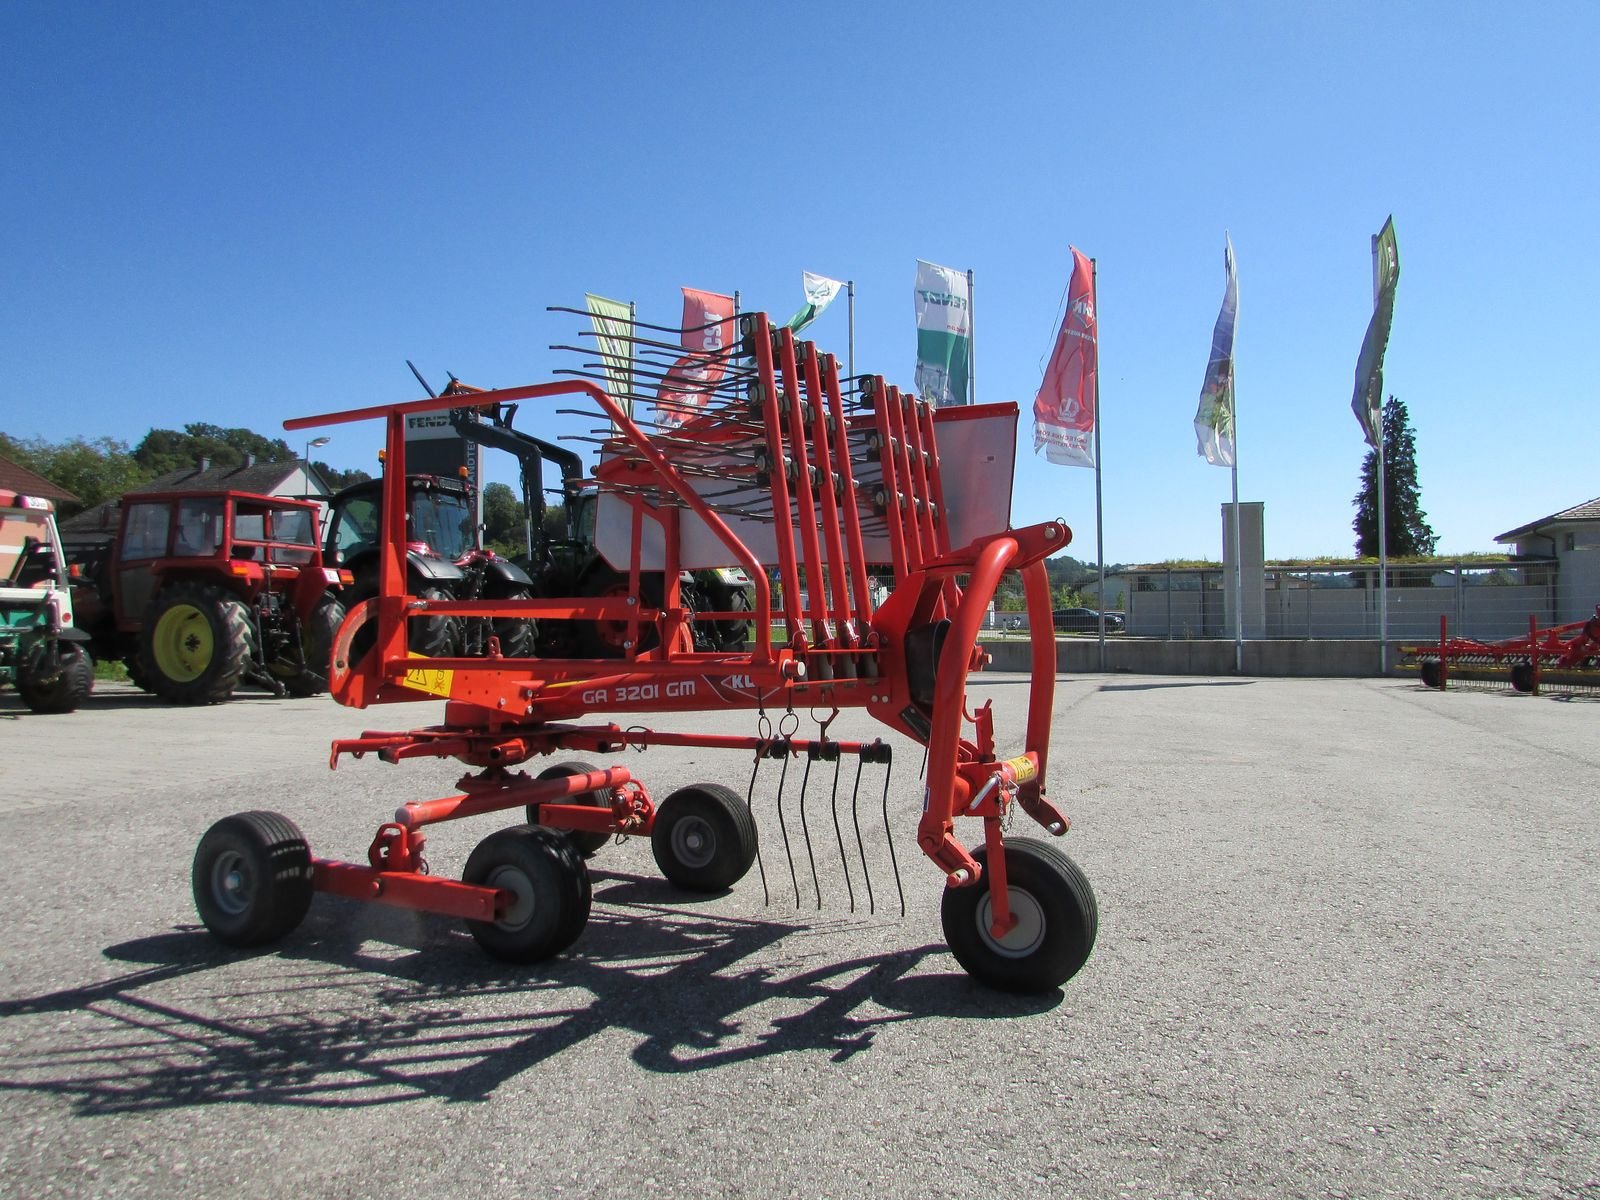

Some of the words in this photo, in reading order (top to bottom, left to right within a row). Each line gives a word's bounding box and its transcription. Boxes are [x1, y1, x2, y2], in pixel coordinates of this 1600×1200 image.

[408, 416, 449, 428] FEND
[582, 689, 608, 704] GA
[615, 685, 659, 702] 3201
[666, 680, 696, 697] GM
